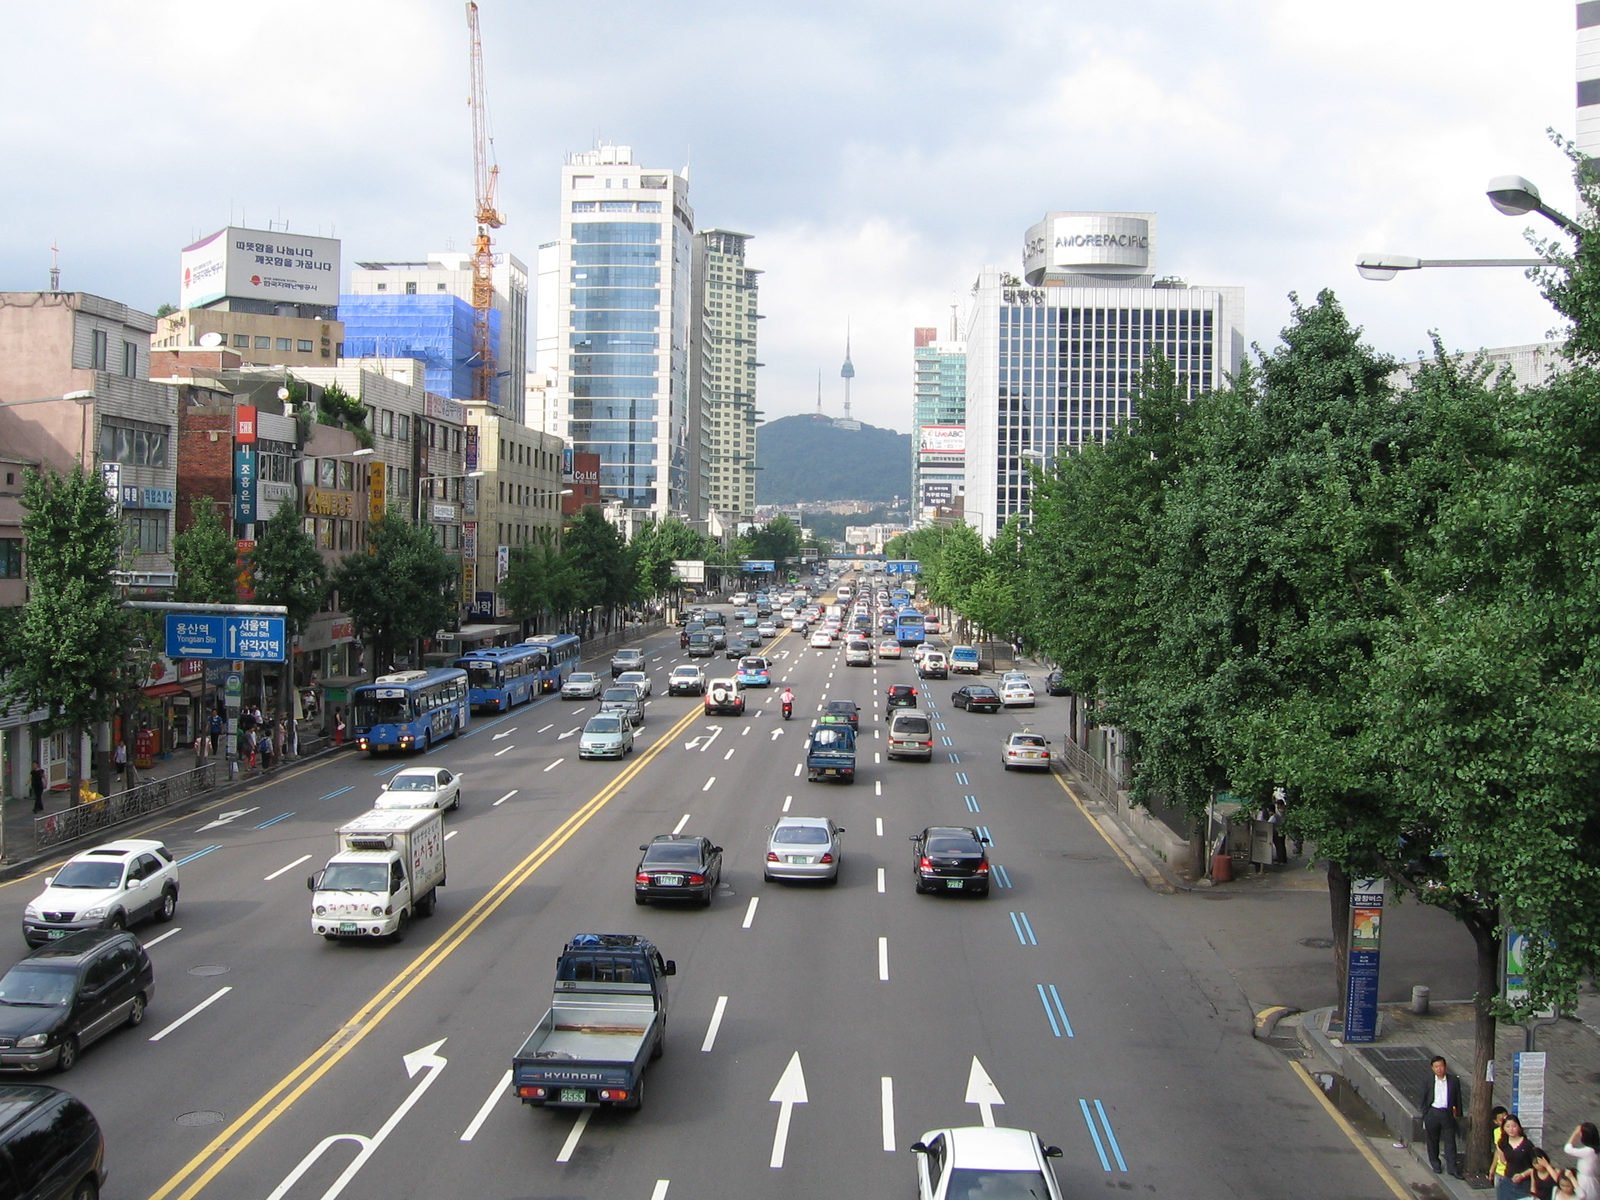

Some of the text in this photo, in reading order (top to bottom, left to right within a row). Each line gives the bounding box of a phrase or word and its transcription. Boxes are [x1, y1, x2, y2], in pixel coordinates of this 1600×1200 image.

[236, 241, 274, 254] 따뜻함을
[1055, 234, 1148, 249] AMOREPACIFIC
[241, 464, 250, 515] 조흥은행
[176, 623, 209, 635] 용산역
[239, 620, 269, 631] 서울역
[176, 635, 205, 644] Yongsan
[239, 640, 279, 652] 삼각지역
[544, 1072, 602, 1080] HYUNDAI
[561, 1093, 585, 1102] 2553
